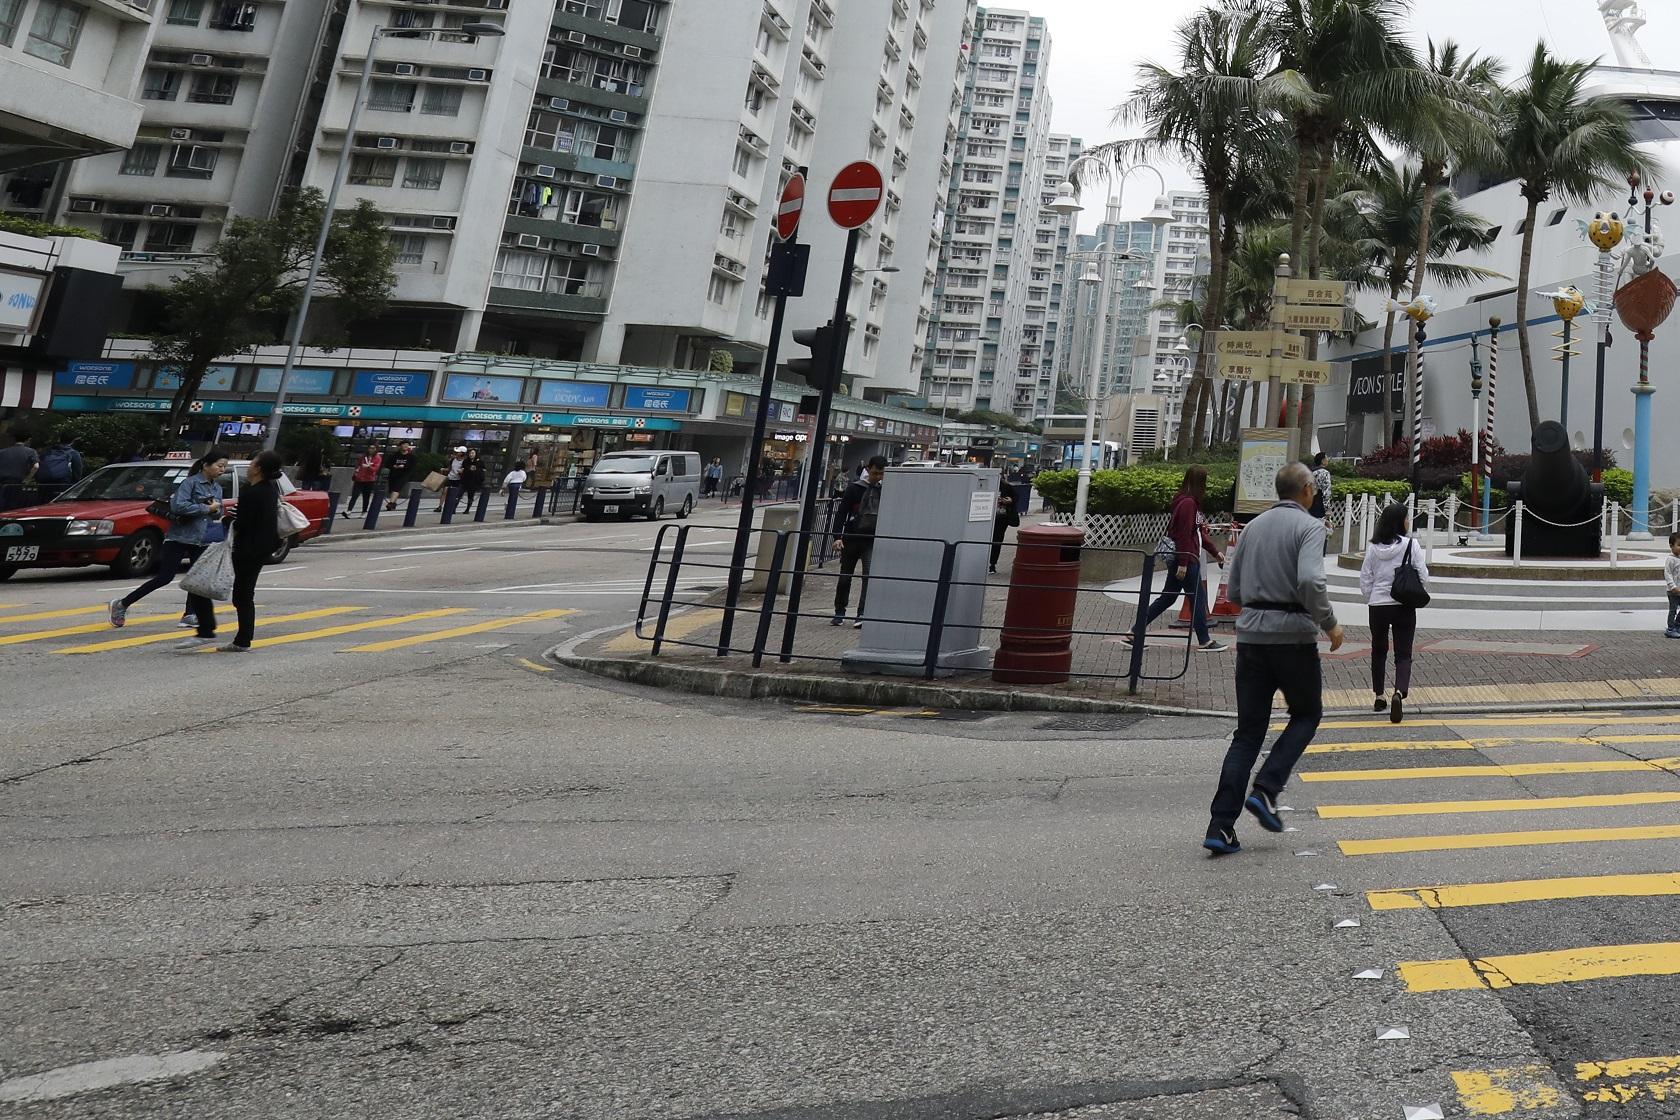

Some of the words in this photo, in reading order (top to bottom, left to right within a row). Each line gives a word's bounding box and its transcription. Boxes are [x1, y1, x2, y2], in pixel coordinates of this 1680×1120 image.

[1376, 372, 1403, 394] STLE
[115, 400, 155, 409] watsons
[578, 417, 609, 425] watsons
